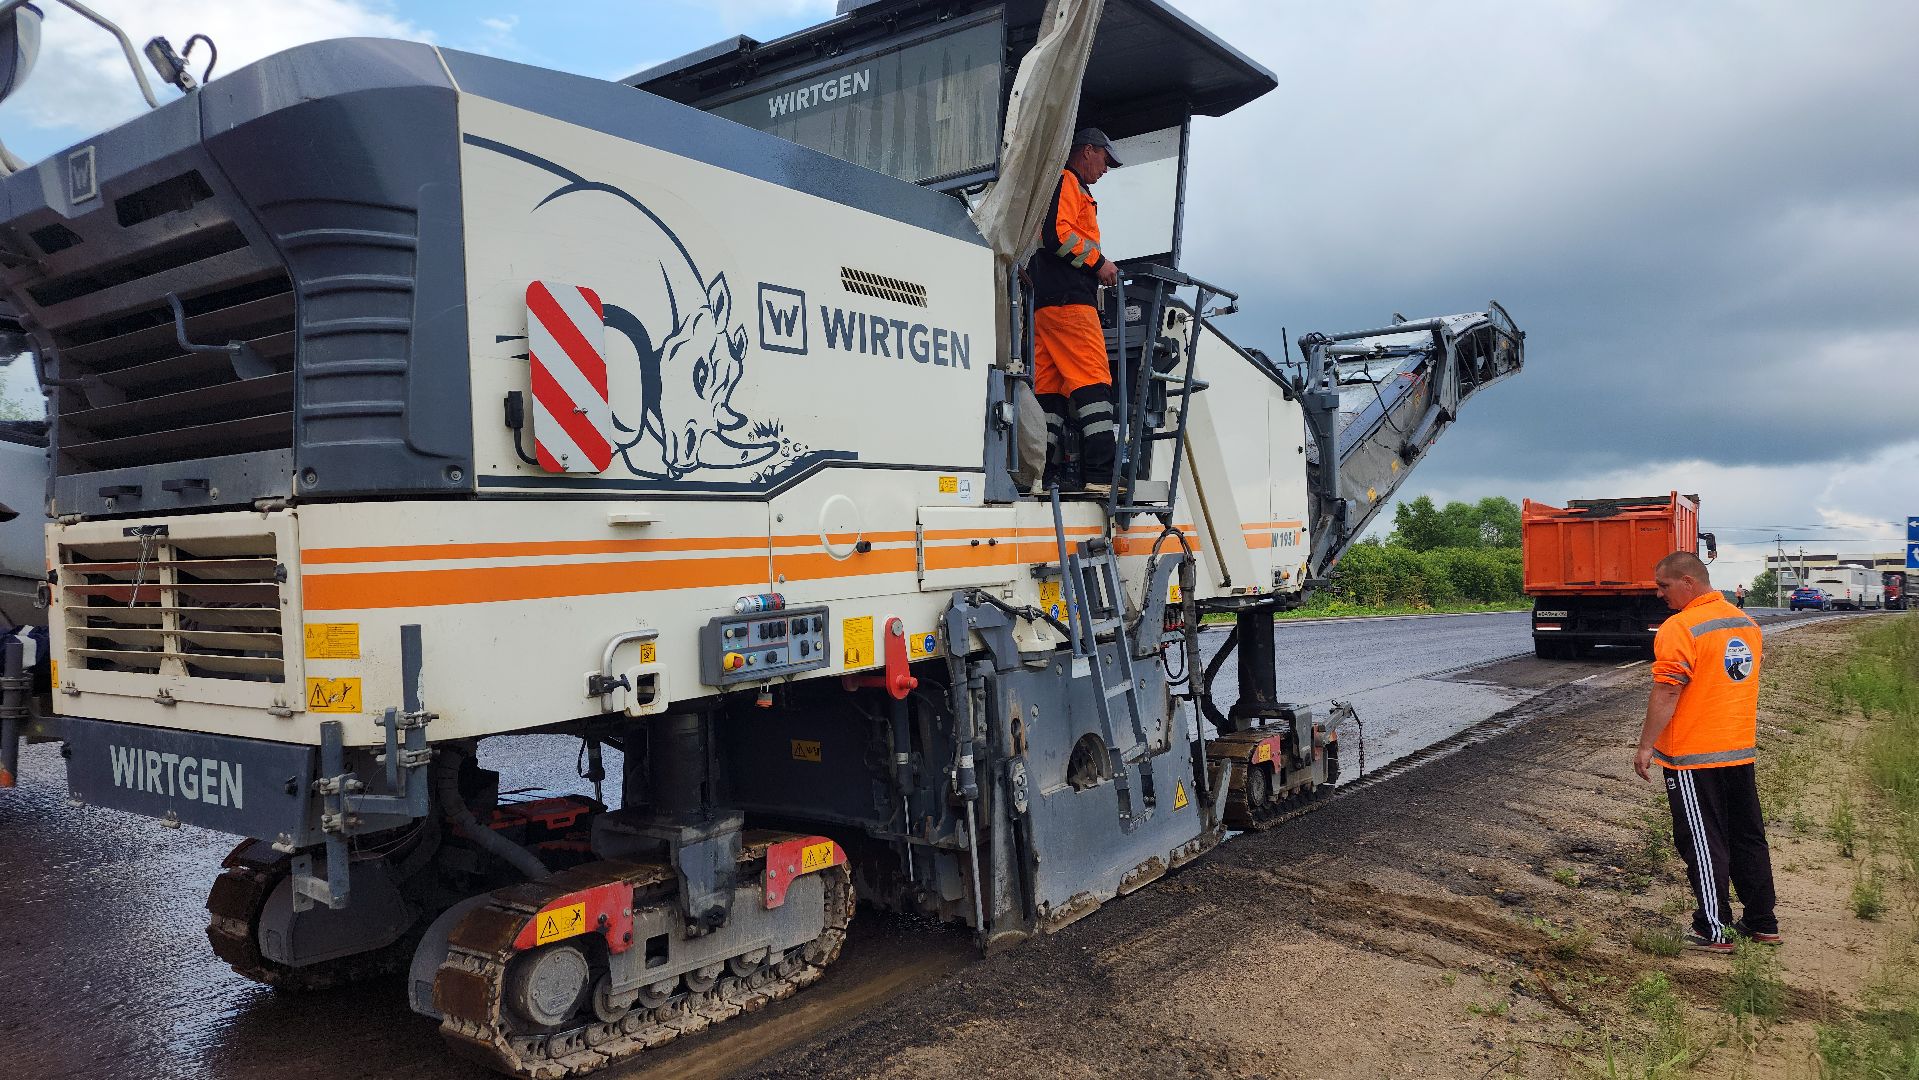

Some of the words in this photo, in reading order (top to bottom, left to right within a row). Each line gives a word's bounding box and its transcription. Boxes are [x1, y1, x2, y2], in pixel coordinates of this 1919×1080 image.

[768, 68, 870, 119] WIRTGEN
[765, 299, 800, 338] W
[820, 304, 971, 370] WIRTGEN
[1271, 532, 1279, 548] W
[109, 744, 243, 810] WIRTGEN
